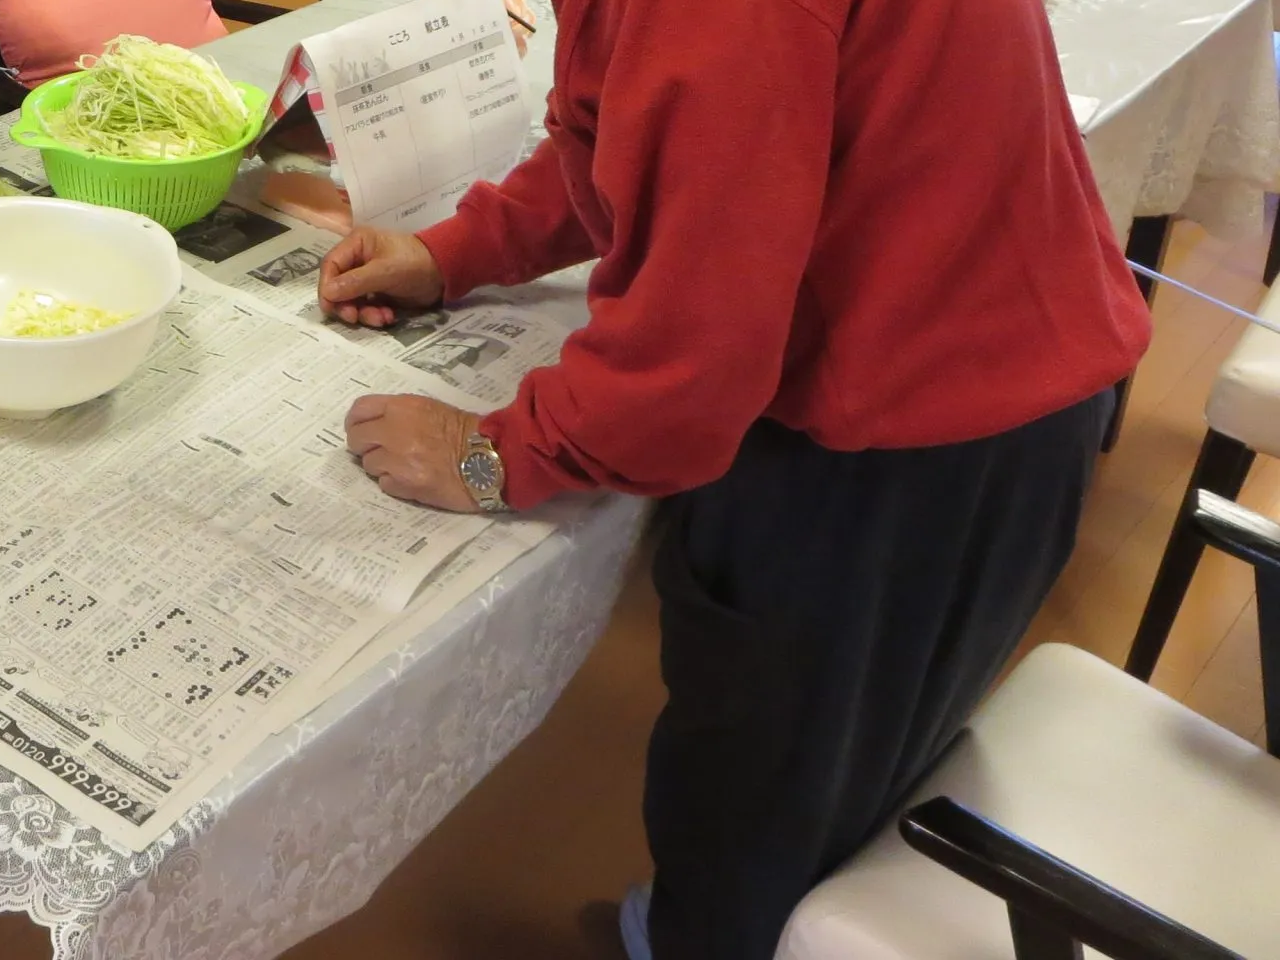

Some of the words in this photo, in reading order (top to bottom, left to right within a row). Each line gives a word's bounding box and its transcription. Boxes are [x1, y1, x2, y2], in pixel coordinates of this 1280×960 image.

[388, 29, 410, 46] こころ
[12, 737, 133, 812] 0120-999-999
